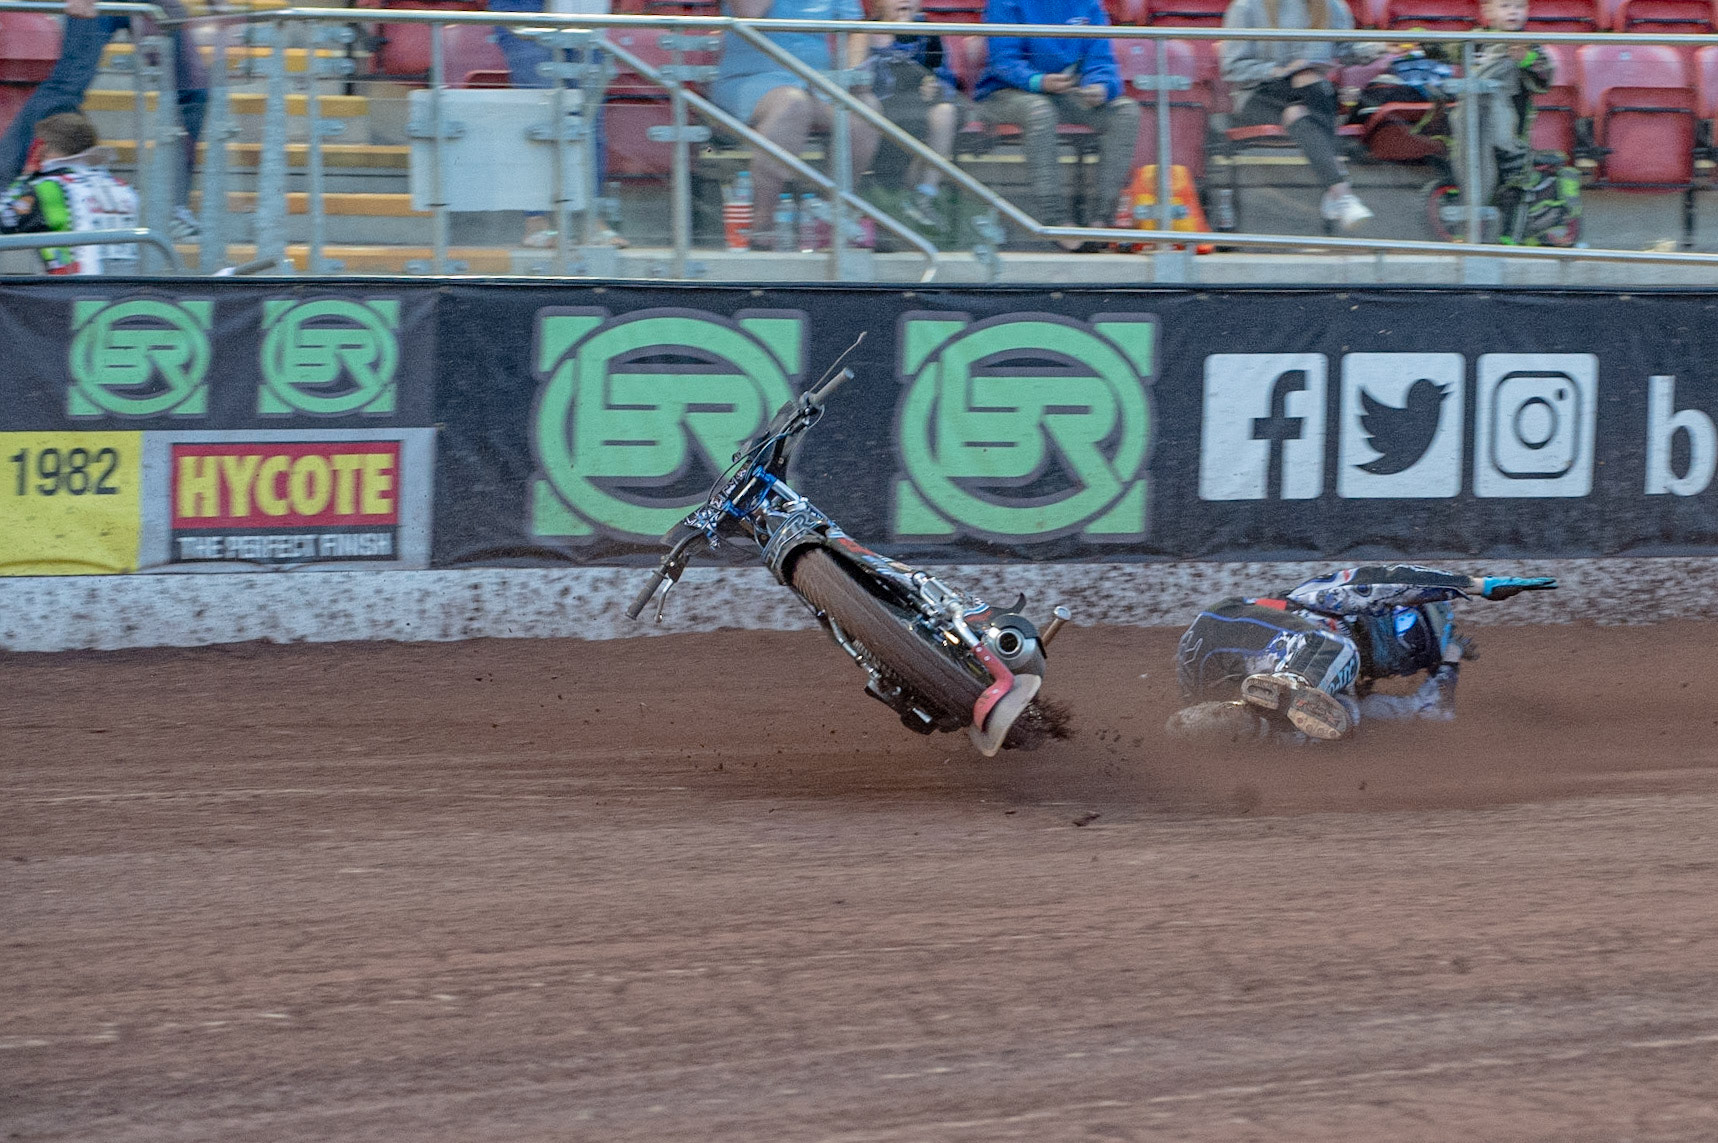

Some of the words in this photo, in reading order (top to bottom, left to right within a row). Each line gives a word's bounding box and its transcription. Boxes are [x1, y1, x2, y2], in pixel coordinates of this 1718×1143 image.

[1644, 374, 1718, 497] b
[11, 447, 119, 496] 1982
[176, 453, 395, 518] HYCOTE
[176, 537, 224, 559] THE
[226, 535, 317, 558] PERFECT
[319, 533, 392, 556] FINISH
